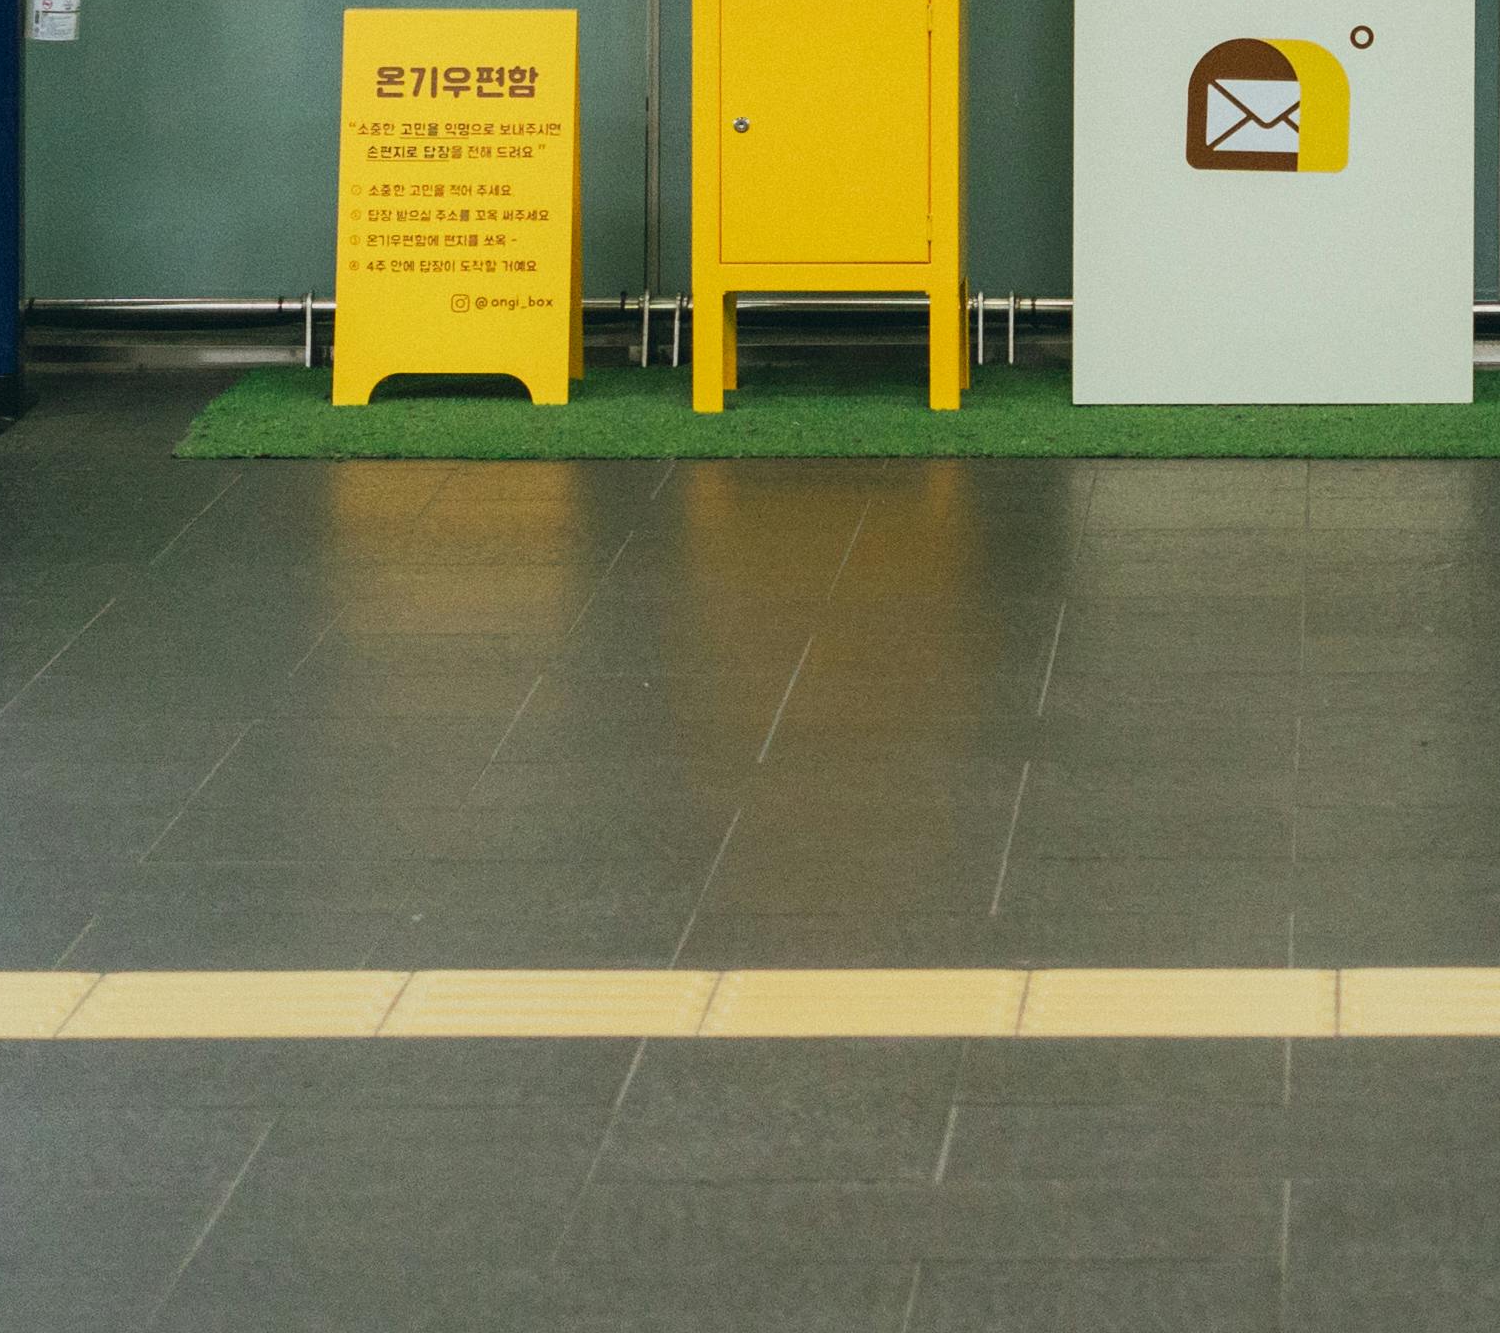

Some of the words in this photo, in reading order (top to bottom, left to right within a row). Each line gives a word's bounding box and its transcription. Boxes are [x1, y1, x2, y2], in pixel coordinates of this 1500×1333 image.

[376, 65, 539, 99] 온기우편함
[402, 123, 438, 136] 고민을
[445, 123, 494, 136] 익명으로
[500, 123, 561, 136] 보내주시면
[367, 146, 417, 159] 손편지로
[424, 145, 462, 159] 답장을
[468, 146, 492, 159] 전해
[369, 185, 404, 197] 소중한
[410, 185, 444, 197] 고민을
[477, 185, 511, 196] 주세요
[368, 210, 391, 221] 답장
[436, 210, 469, 221] 주소를
[367, 235, 439, 247] 온기우편함에
[445, 235, 478, 246] 편지를
[366, 261, 386, 271] 4주
[391, 261, 414, 272] 안에
[420, 261, 455, 273] 답장이
